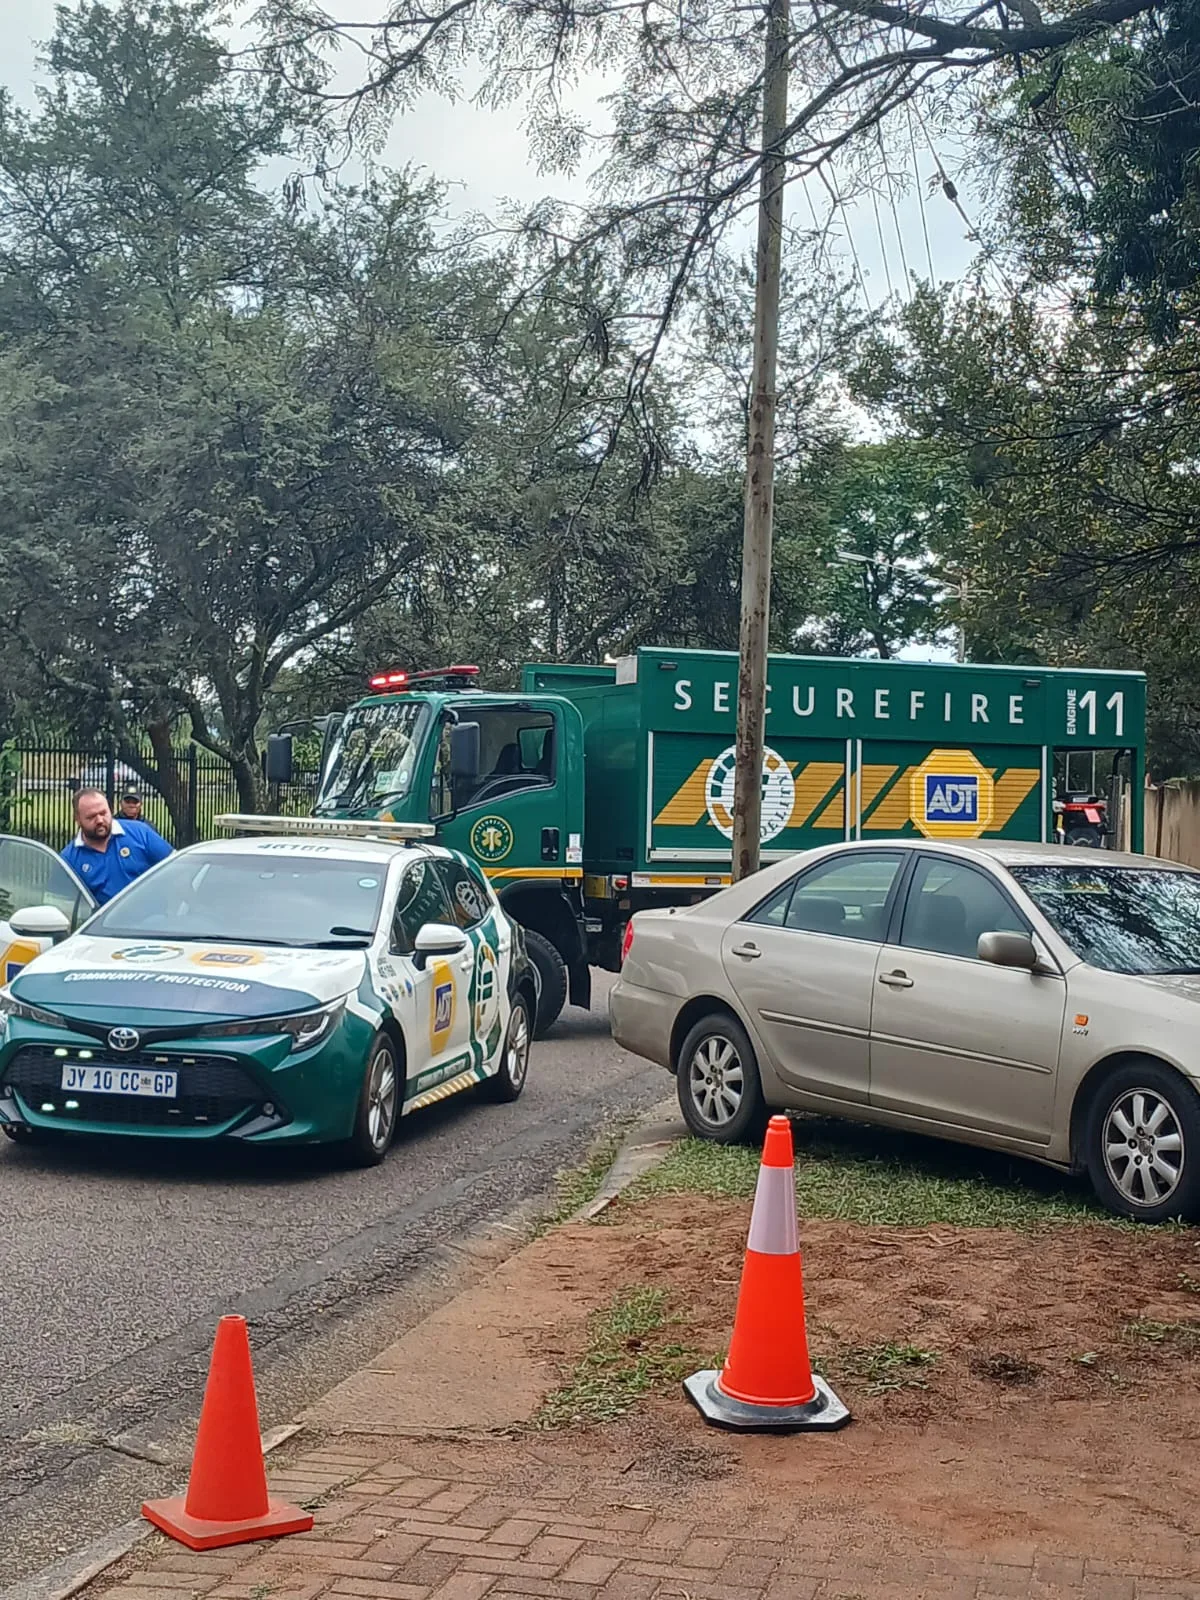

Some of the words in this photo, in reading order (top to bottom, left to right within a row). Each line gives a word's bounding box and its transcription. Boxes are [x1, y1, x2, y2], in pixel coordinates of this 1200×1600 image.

[1066, 689, 1077, 735] ENGINE
[1078, 690, 1124, 737] 11
[927, 783, 977, 814] ADT
[64, 972, 155, 982] COMMUNITY
[155, 974, 250, 993] PROTECTION
[67, 1068, 86, 1088] JY
[93, 1070, 112, 1090] 10
[120, 1072, 139, 1091] CC
[154, 1074, 173, 1094] GP
